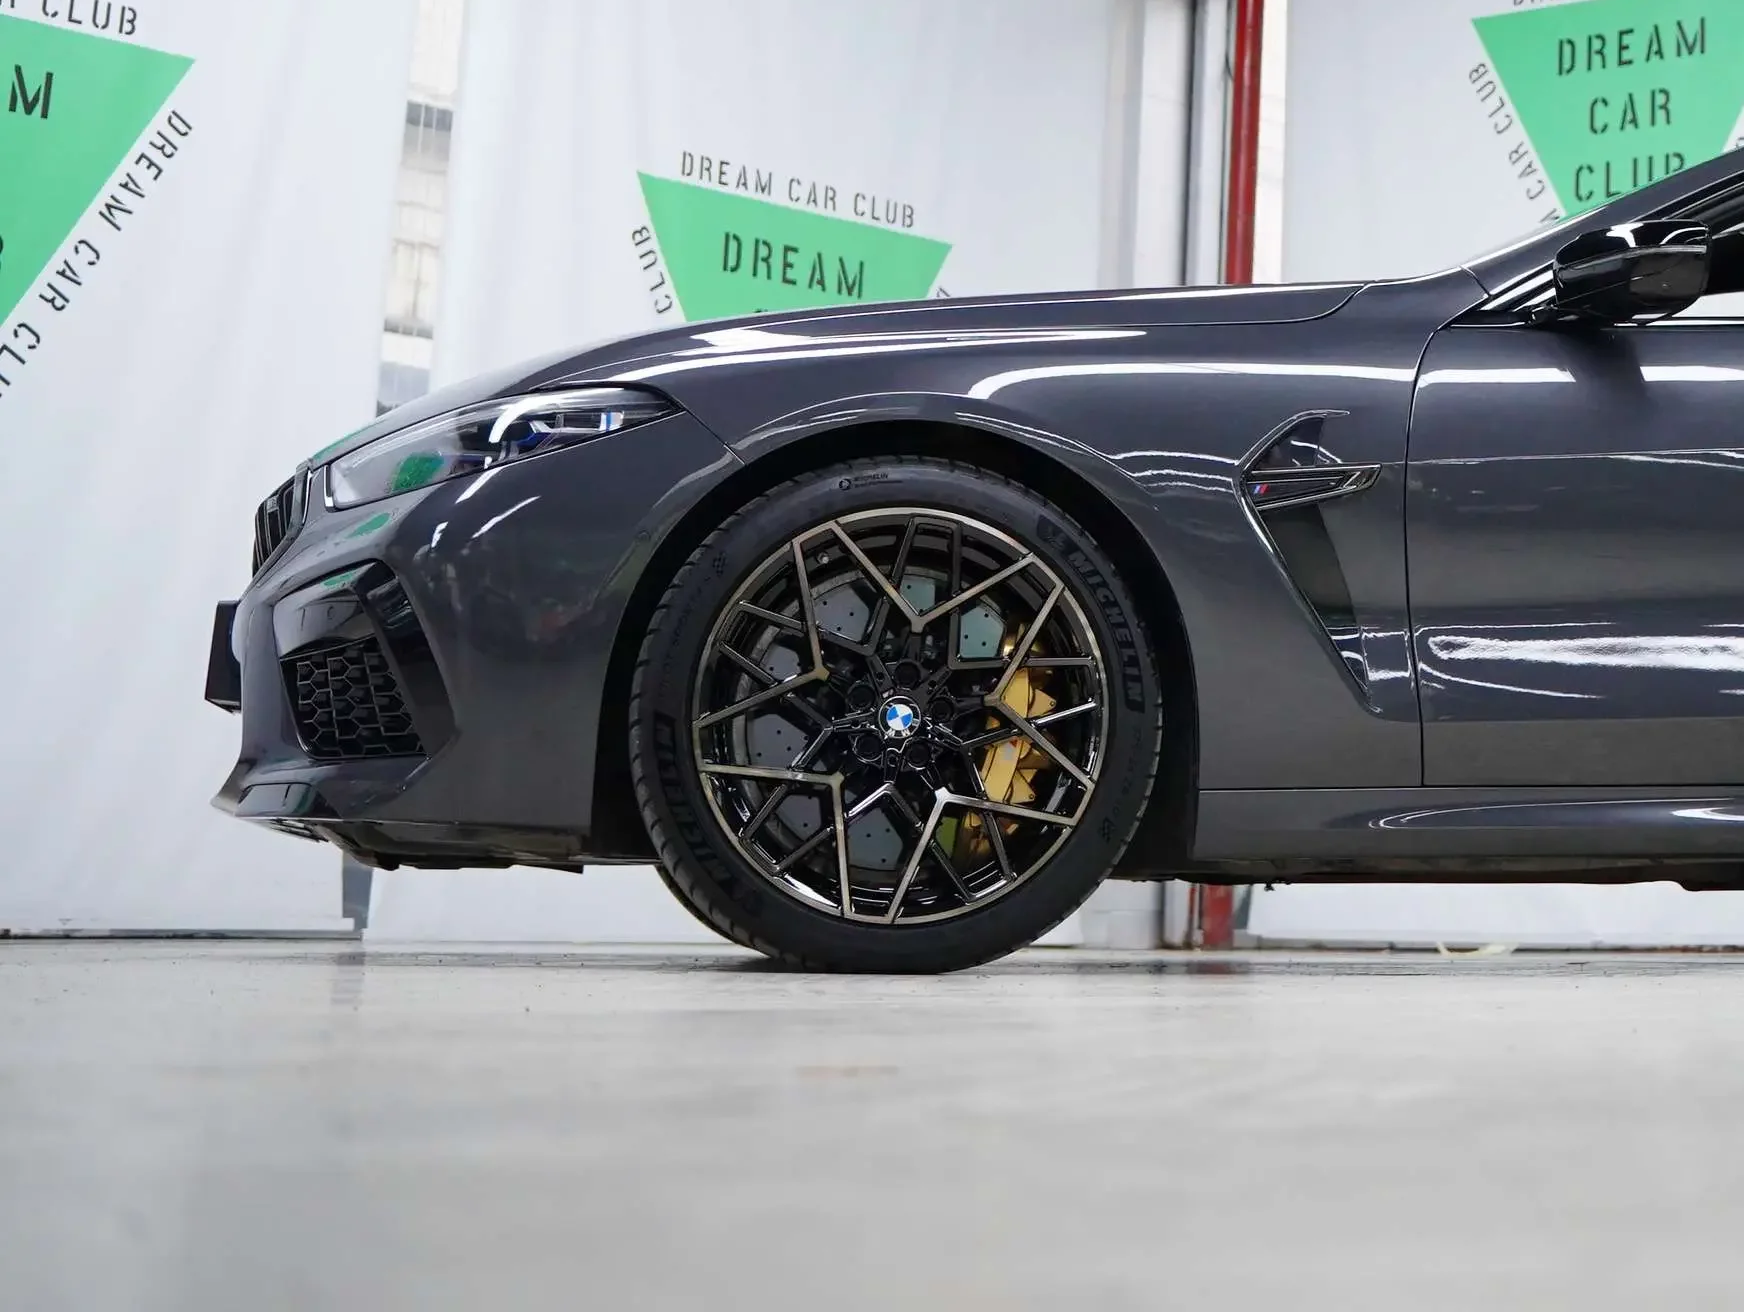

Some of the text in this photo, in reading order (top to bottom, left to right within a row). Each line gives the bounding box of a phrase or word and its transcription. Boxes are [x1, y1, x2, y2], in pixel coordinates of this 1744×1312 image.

[1557, 16, 1707, 77] DREAM
[1468, 62, 1546, 201] CAR CLUB
[1589, 87, 1672, 136] CAR
[98, 109, 193, 232] DREAM
[681, 150, 915, 228] DREAM CAR CLUB
[39, 239, 102, 312] CAR
[631, 225, 674, 315] CLUB
[722, 231, 865, 299] DREAM
